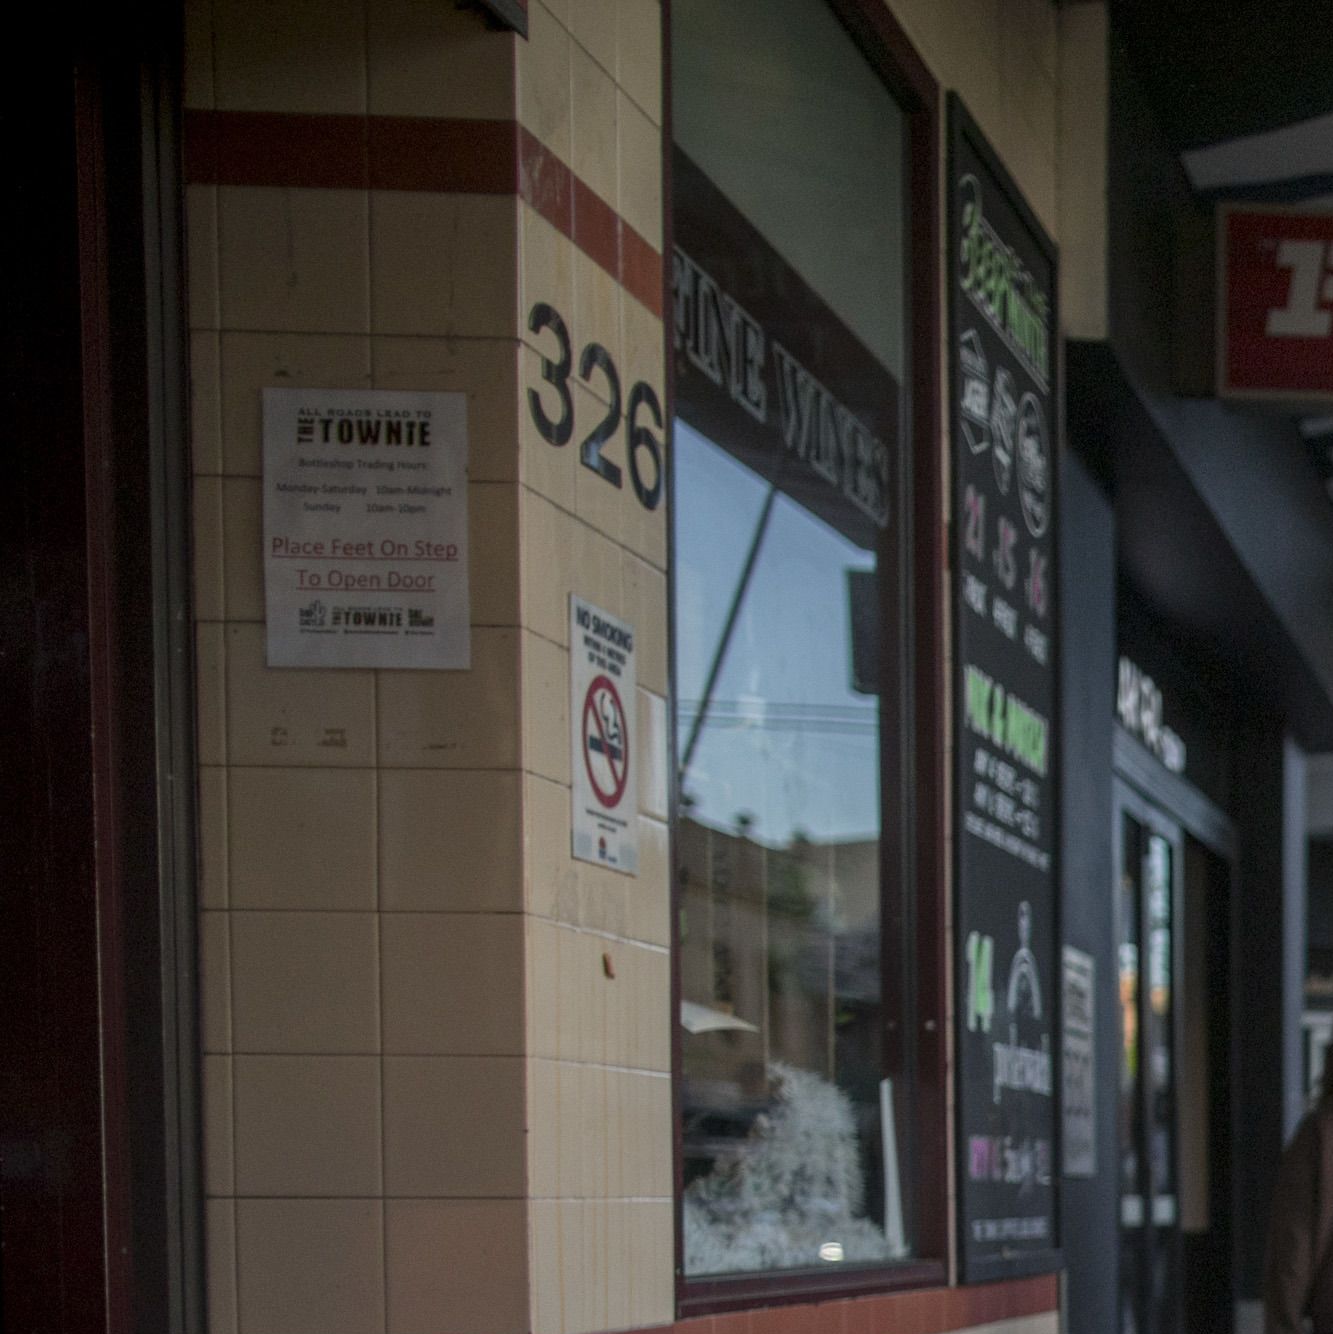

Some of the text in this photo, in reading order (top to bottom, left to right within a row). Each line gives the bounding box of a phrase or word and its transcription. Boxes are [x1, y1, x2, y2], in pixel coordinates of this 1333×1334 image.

[527, 302, 666, 511] 326
[320, 418, 431, 447] TOWNIE
[773, 342, 890, 529] WINES
[357, 458, 395, 472] Trading
[303, 502, 341, 514] Sunday
[272, 537, 458, 562] Place Feet On Step
[296, 569, 435, 592] To Open Door
